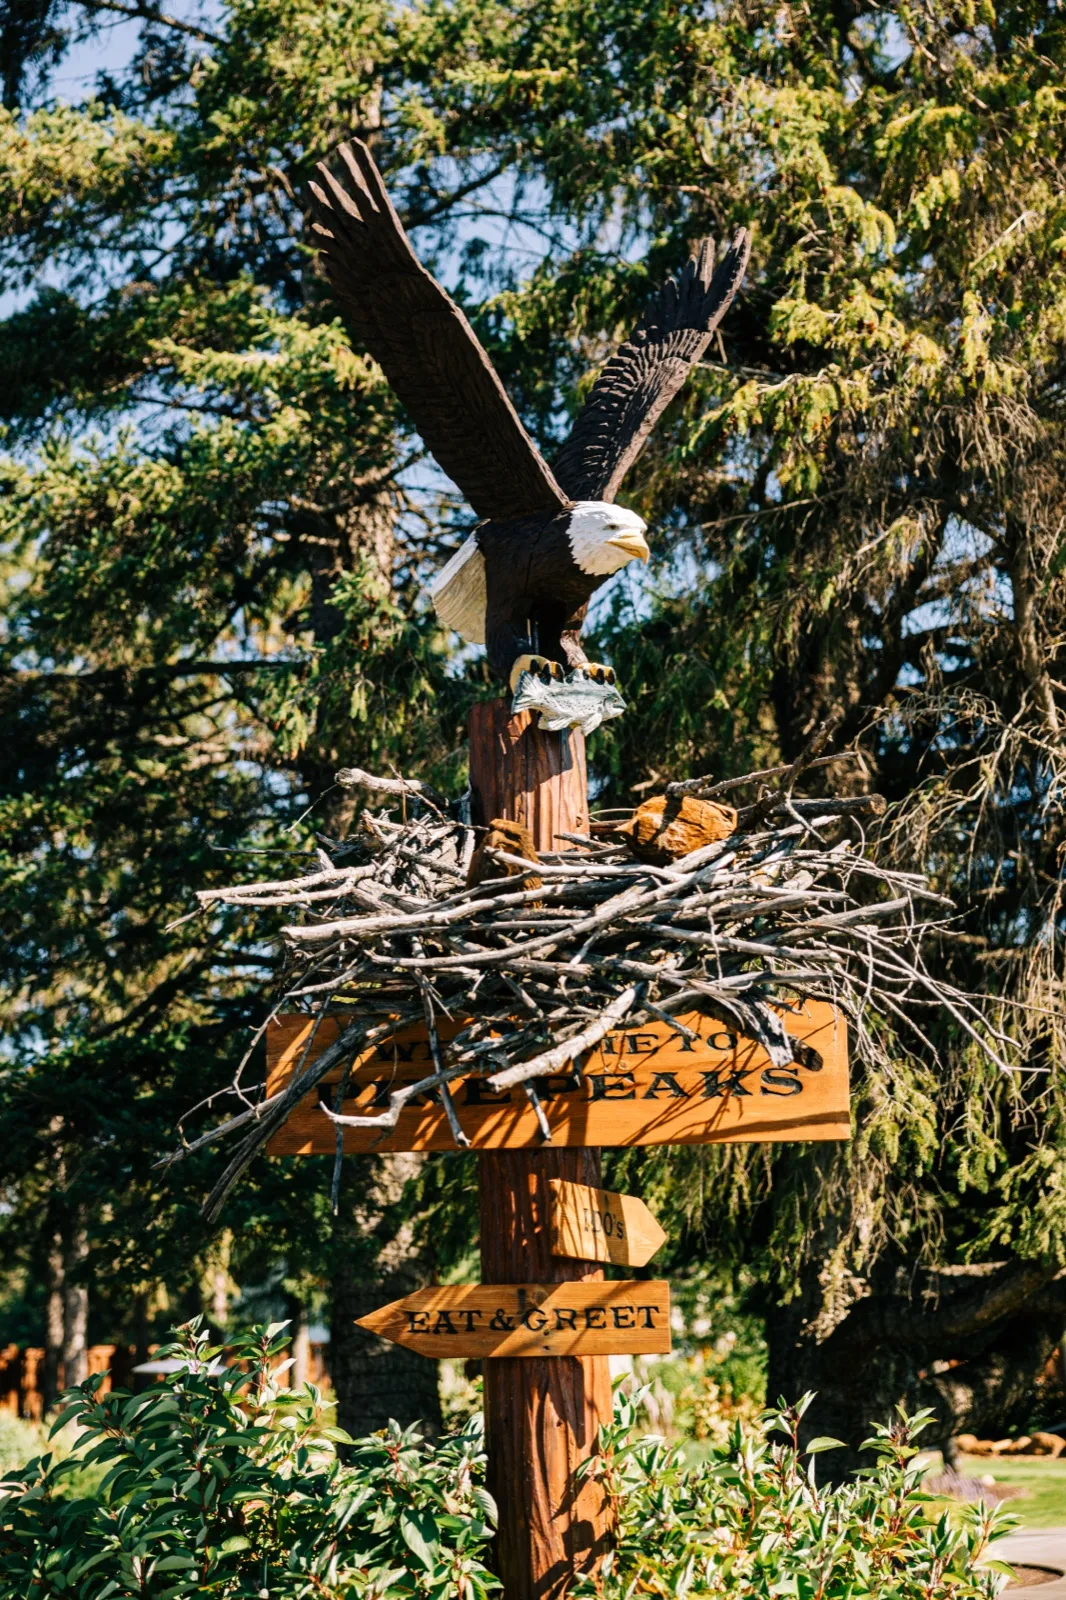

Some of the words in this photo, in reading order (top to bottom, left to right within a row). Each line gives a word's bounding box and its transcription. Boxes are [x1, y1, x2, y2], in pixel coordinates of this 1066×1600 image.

[669, 1032, 739, 1053] TO
[527, 1067, 804, 1102] PEAKS
[404, 1309, 482, 1334] EAT
[489, 1308, 516, 1331] &
[521, 1305, 660, 1332] GREET
